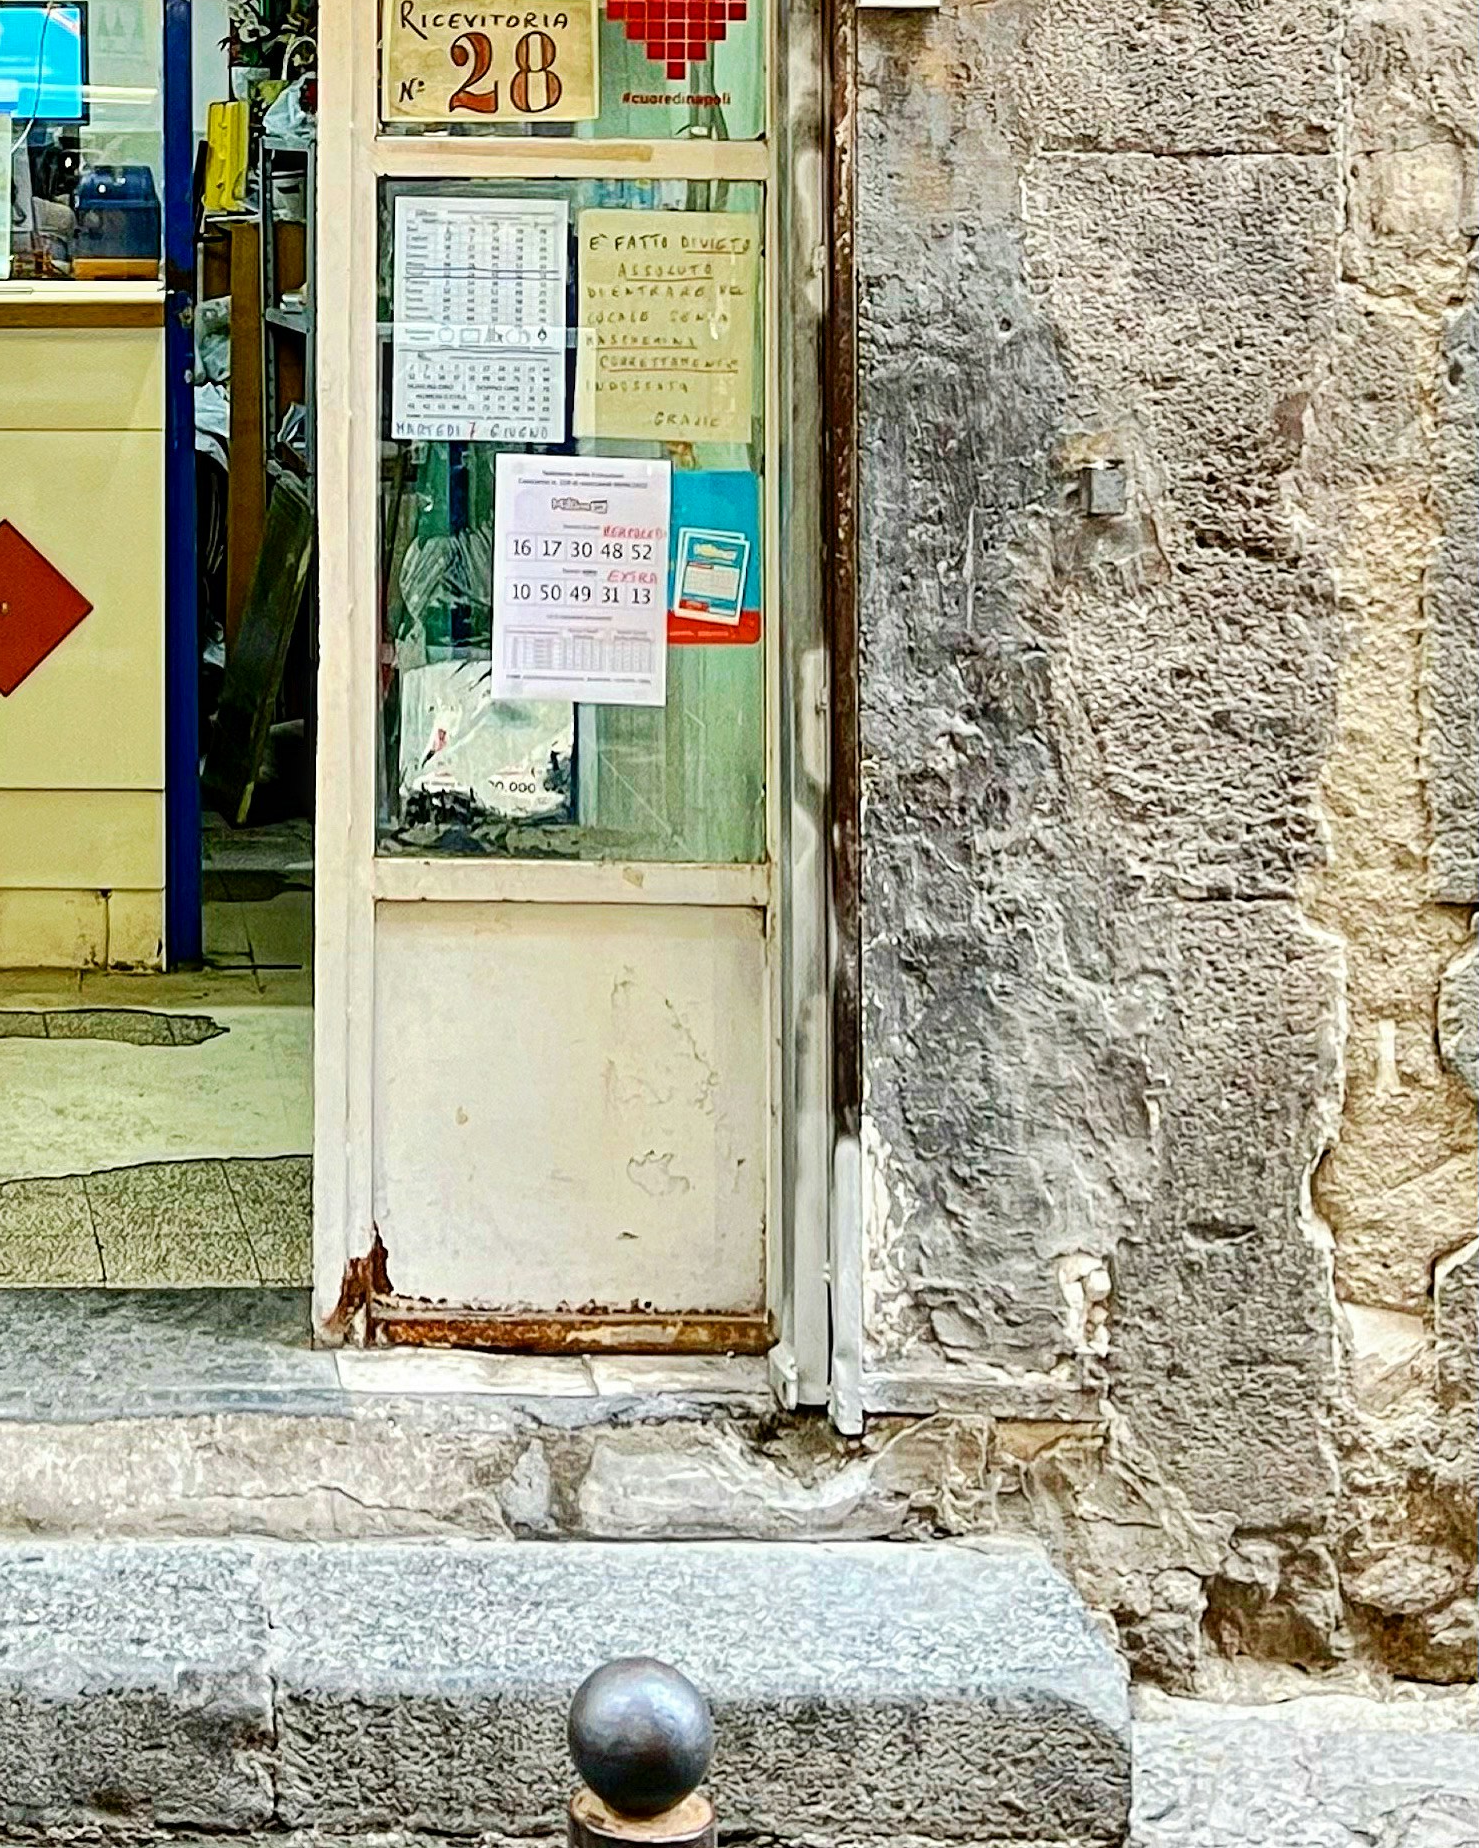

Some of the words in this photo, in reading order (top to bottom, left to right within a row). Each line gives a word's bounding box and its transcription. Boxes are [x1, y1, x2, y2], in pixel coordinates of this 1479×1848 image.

[400, 0, 568, 40] RICEVITORIA
[448, 30, 563, 113] 28
[614, 233, 668, 252] FATTO
[681, 235, 751, 253] DIVIETO
[617, 262, 713, 279] ASSOLUTO
[396, 421, 461, 437] MARTEDI
[490, 423, 549, 440] GIUGNO
[513, 538, 532, 557] 16
[542, 539, 563, 557] 17
[570, 541, 594, 558] 30
[601, 542, 624, 560] 48
[631, 543, 653, 560] 52
[512, 583, 533, 601] 10
[539, 583, 563, 602] 50
[569, 585, 593, 603] 49
[601, 585, 621, 605] 31
[631, 586, 652, 605] 13
